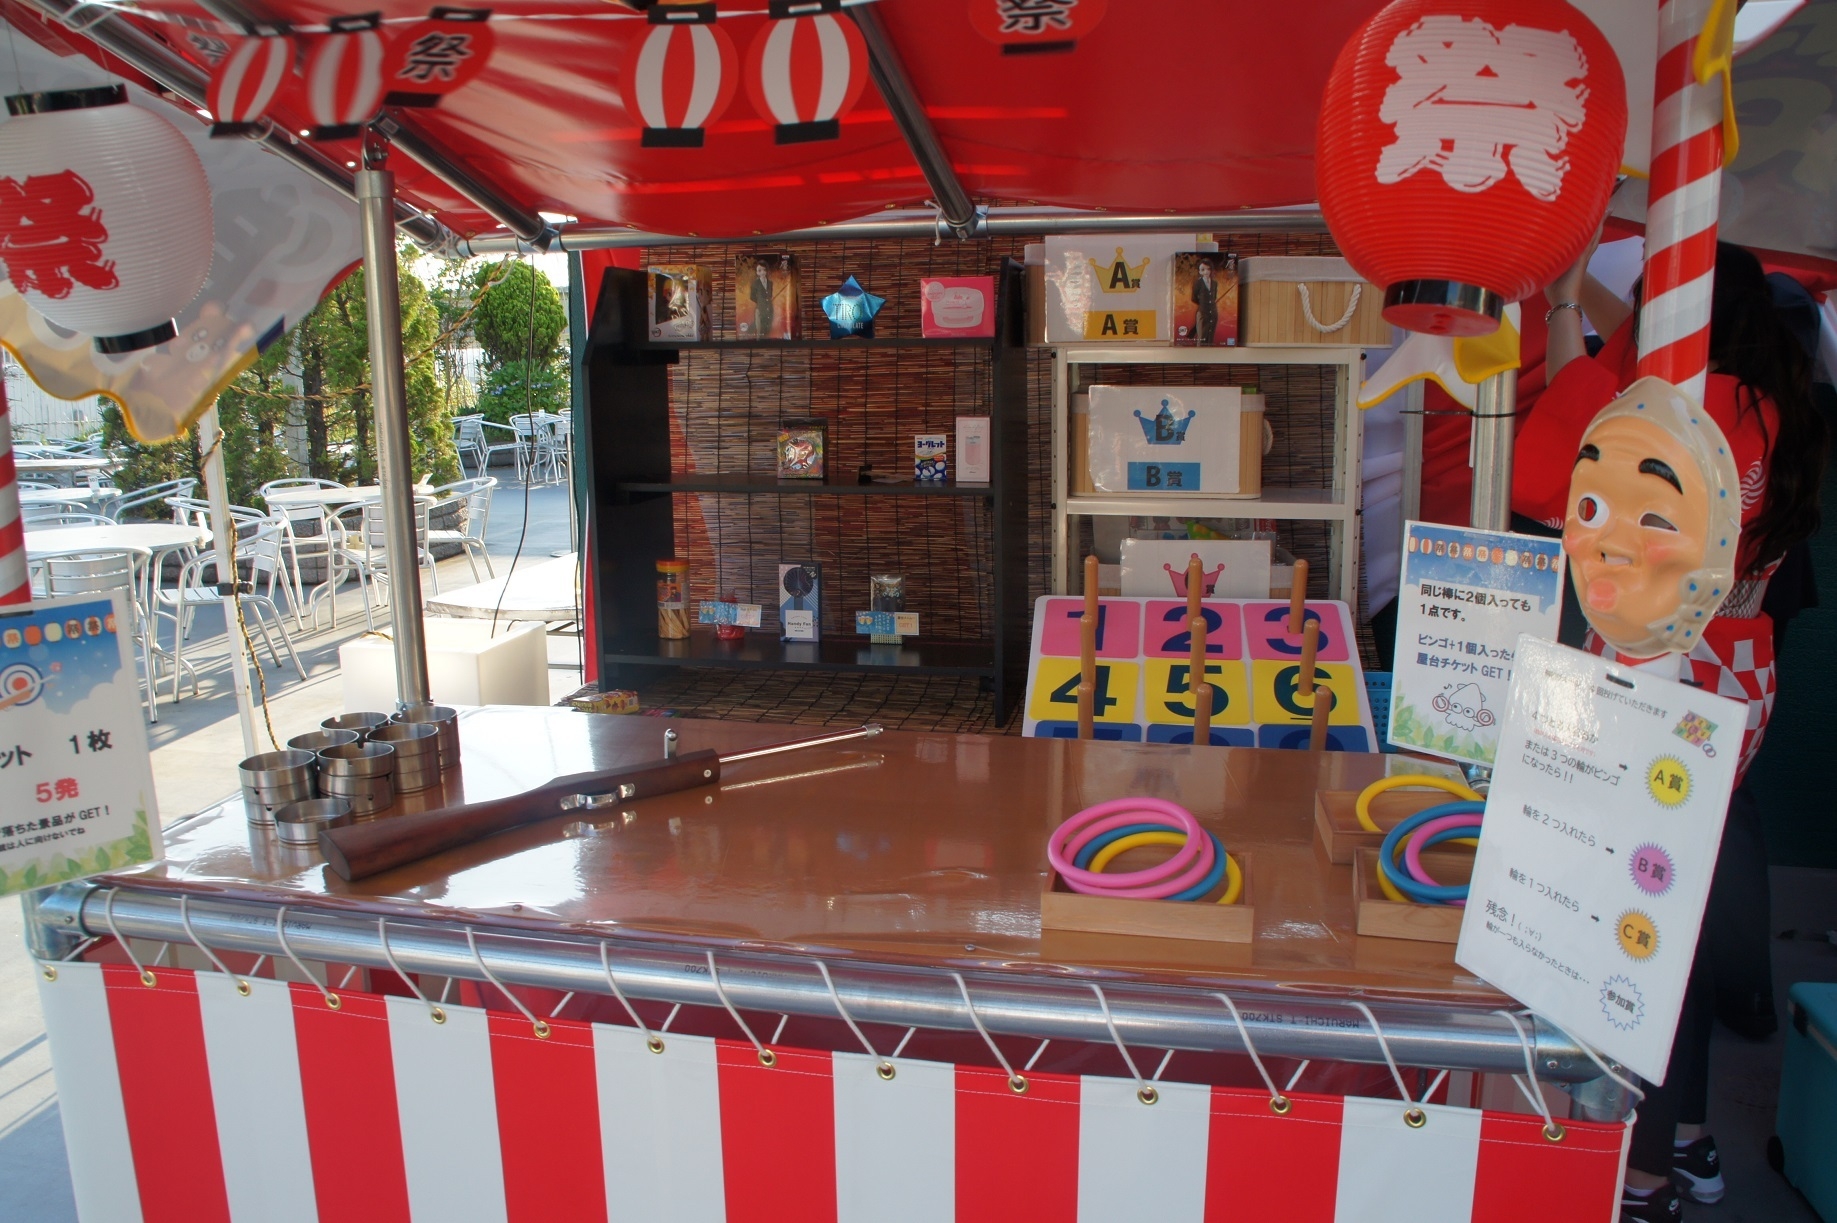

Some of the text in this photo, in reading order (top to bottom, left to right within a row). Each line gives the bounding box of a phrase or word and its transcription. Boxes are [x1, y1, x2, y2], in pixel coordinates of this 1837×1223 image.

[397, 31, 474, 83] 祭
[1374, 14, 1590, 202] 祭
[1109, 261, 1142, 290] A賞
[832, 303, 863, 321] TIRO
[1421, 584, 1531, 612] 同じ棒に2個入っても
[1420, 603, 1466, 622] 1点です。
[1067, 605, 1329, 655] 1 2 3
[1416, 652, 1512, 681] 屋台チケット GET！
[1050, 665, 1338, 720] 4 5 6
[0, 744, 33, 769] ット
[1524, 739, 1621, 786] または3つの輪がビンゴ
[1653, 769, 1684, 793] A賞
[35, 777, 79, 803] 5発
[0, 812, 76, 838] 落ちた景品が
[1522, 804, 1668, 883] 輪を2つ入れたら B賞
[1485, 899, 1516, 927] 残念！
[1508, 867, 1652, 950] 輪を1つ入れたら C賞
[1606, 989, 1636, 1014] 参加賞
[1241, 1012, 1283, 1024] STK700
[1305, 1014, 1361, 1029] MARUICHI
